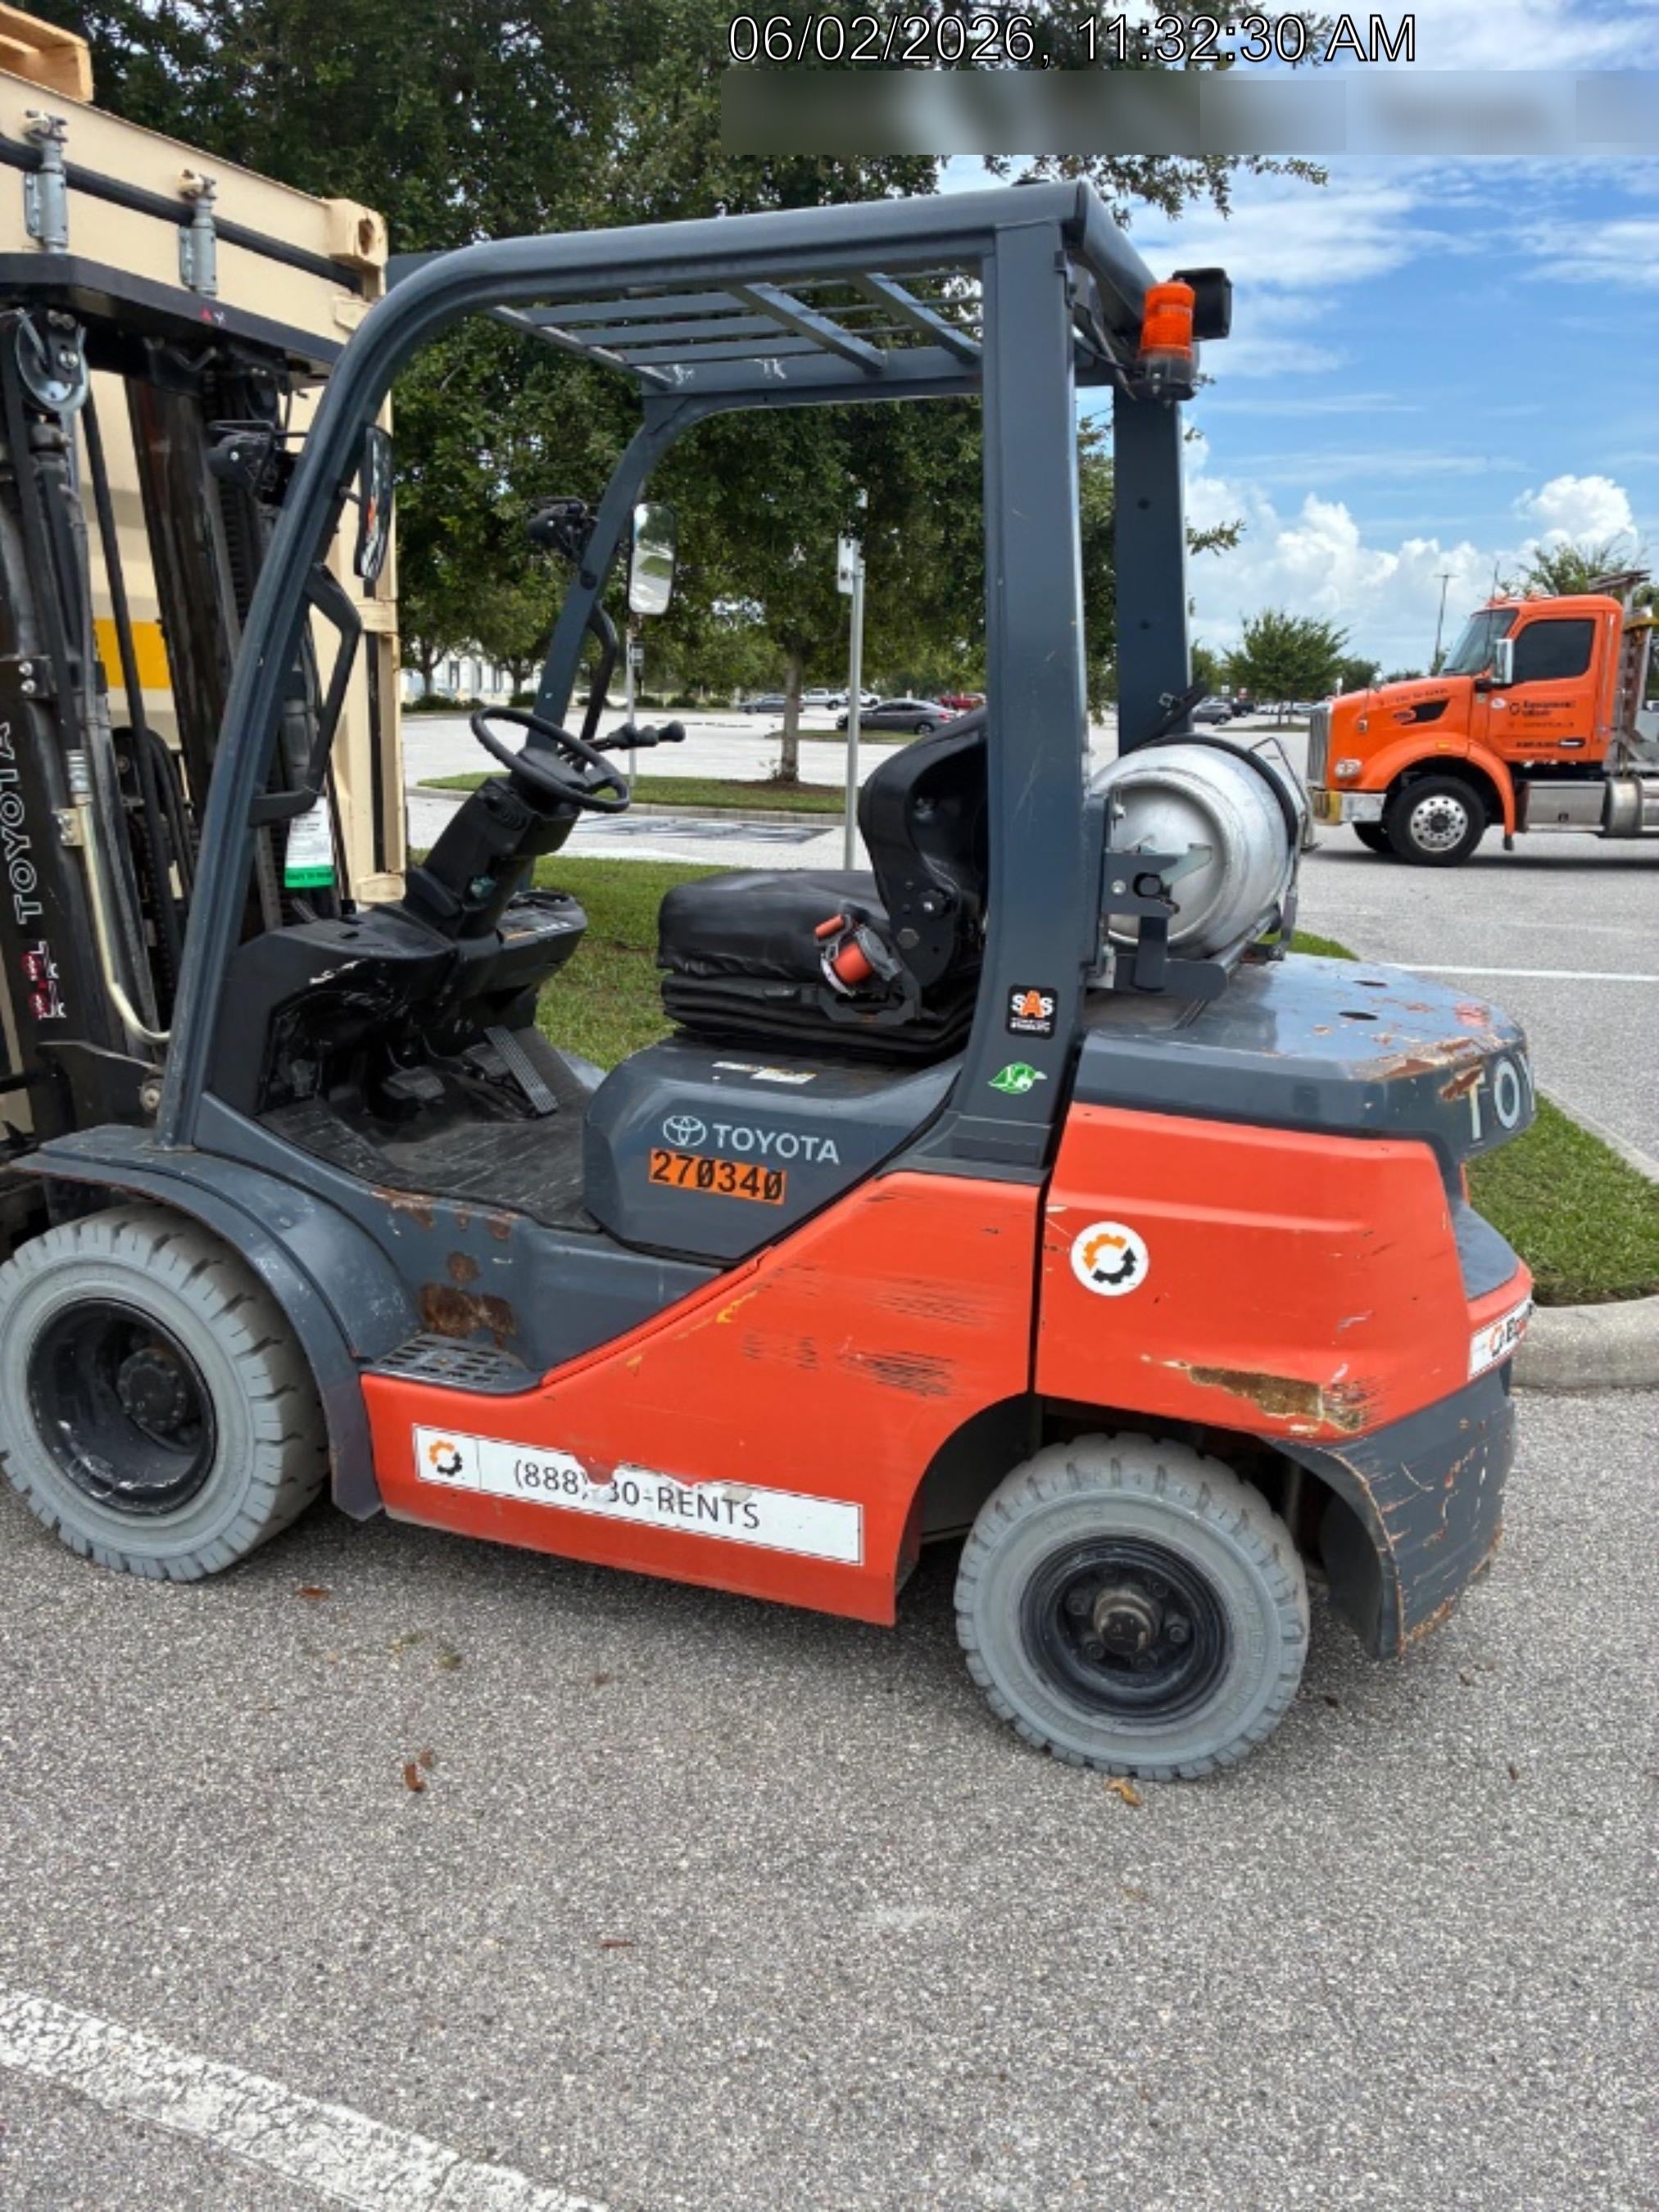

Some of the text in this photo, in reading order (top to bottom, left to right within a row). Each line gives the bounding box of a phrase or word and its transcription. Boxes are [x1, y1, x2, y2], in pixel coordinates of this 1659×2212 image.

[1011, 990, 1054, 1018] SAS
[713, 1124, 840, 1164] TOYOTA
[653, 1152, 782, 1200] 270340
